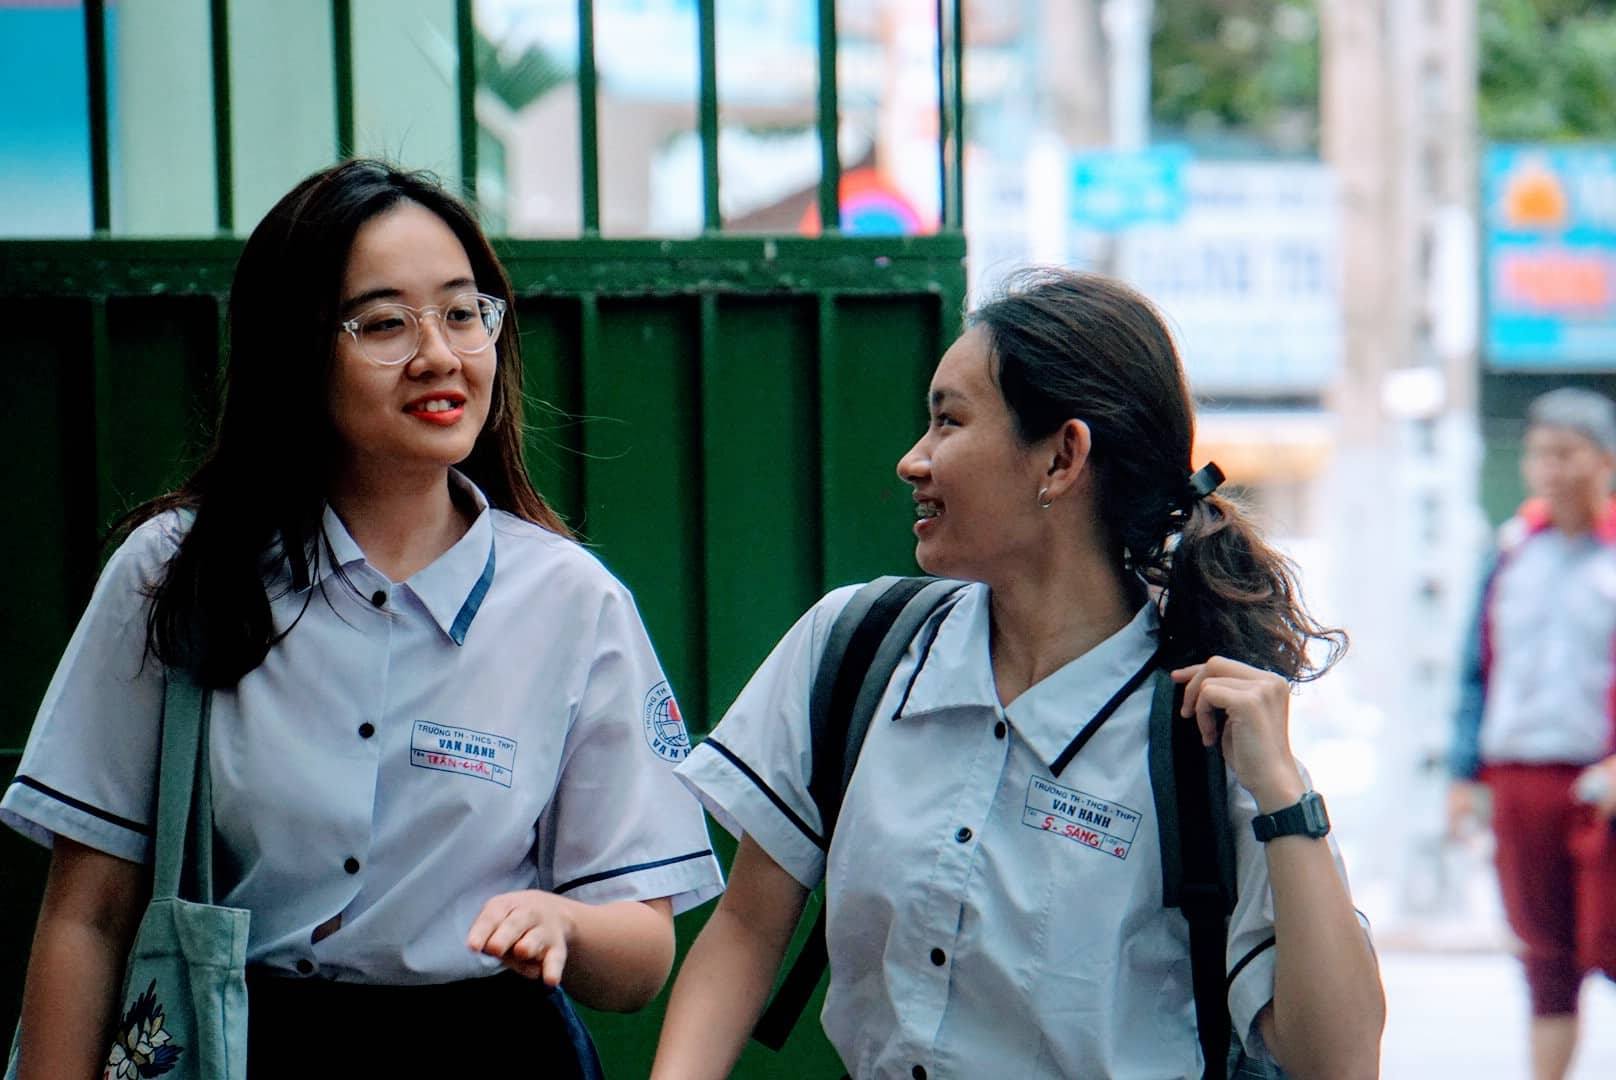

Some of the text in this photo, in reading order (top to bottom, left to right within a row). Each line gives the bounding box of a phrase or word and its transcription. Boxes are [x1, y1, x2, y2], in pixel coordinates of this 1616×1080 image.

[454, 731, 464, 740] TH
[471, 735, 491, 745] THCS
[1070, 794, 1081, 803] TH
[1086, 799, 1108, 812] THCS
[1116, 809, 1137, 823] THPT
[1063, 825, 1099, 847] SANG
